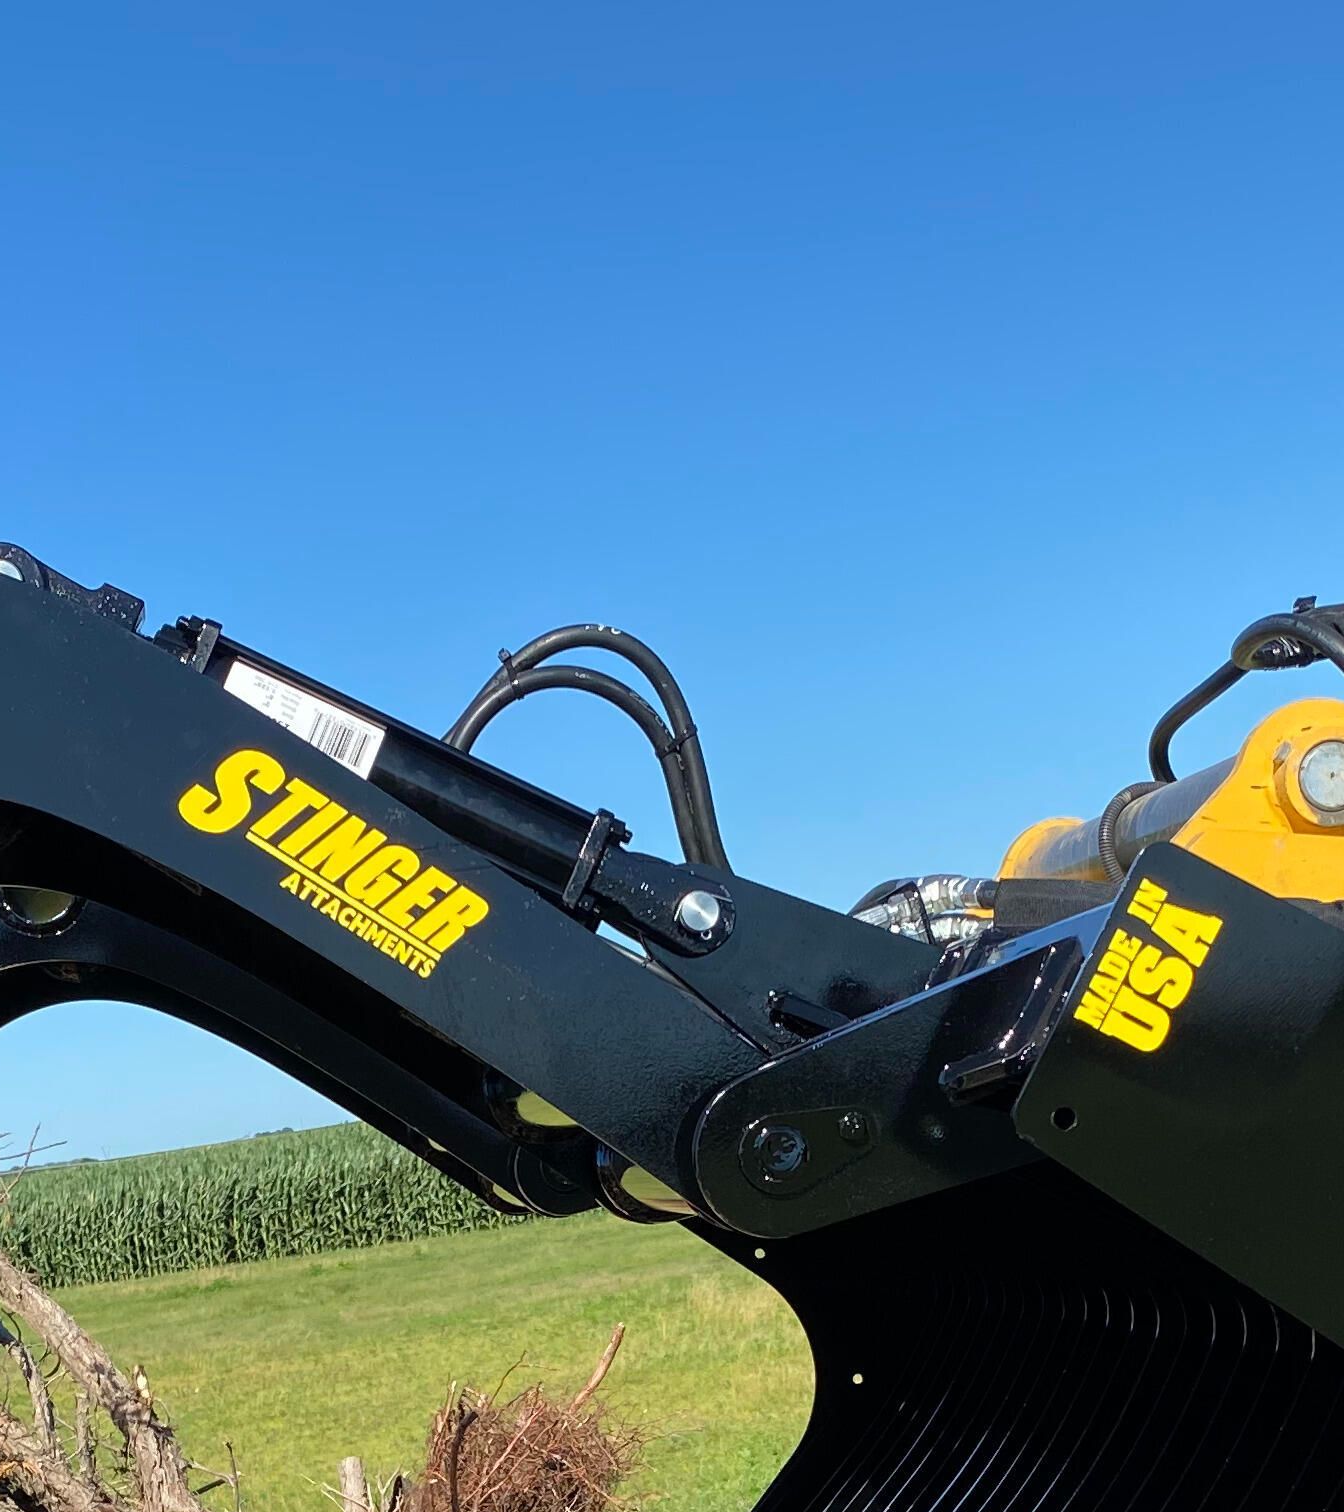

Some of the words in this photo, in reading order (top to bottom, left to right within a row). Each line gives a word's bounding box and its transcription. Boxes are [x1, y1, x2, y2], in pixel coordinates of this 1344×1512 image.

[178, 748, 489, 953] STINGER
[279, 872, 437, 979] ATTACHMENTS
[1073, 928, 1143, 1030] MADE
[1126, 878, 1168, 926] IN
[1099, 902, 1224, 1052] USA
